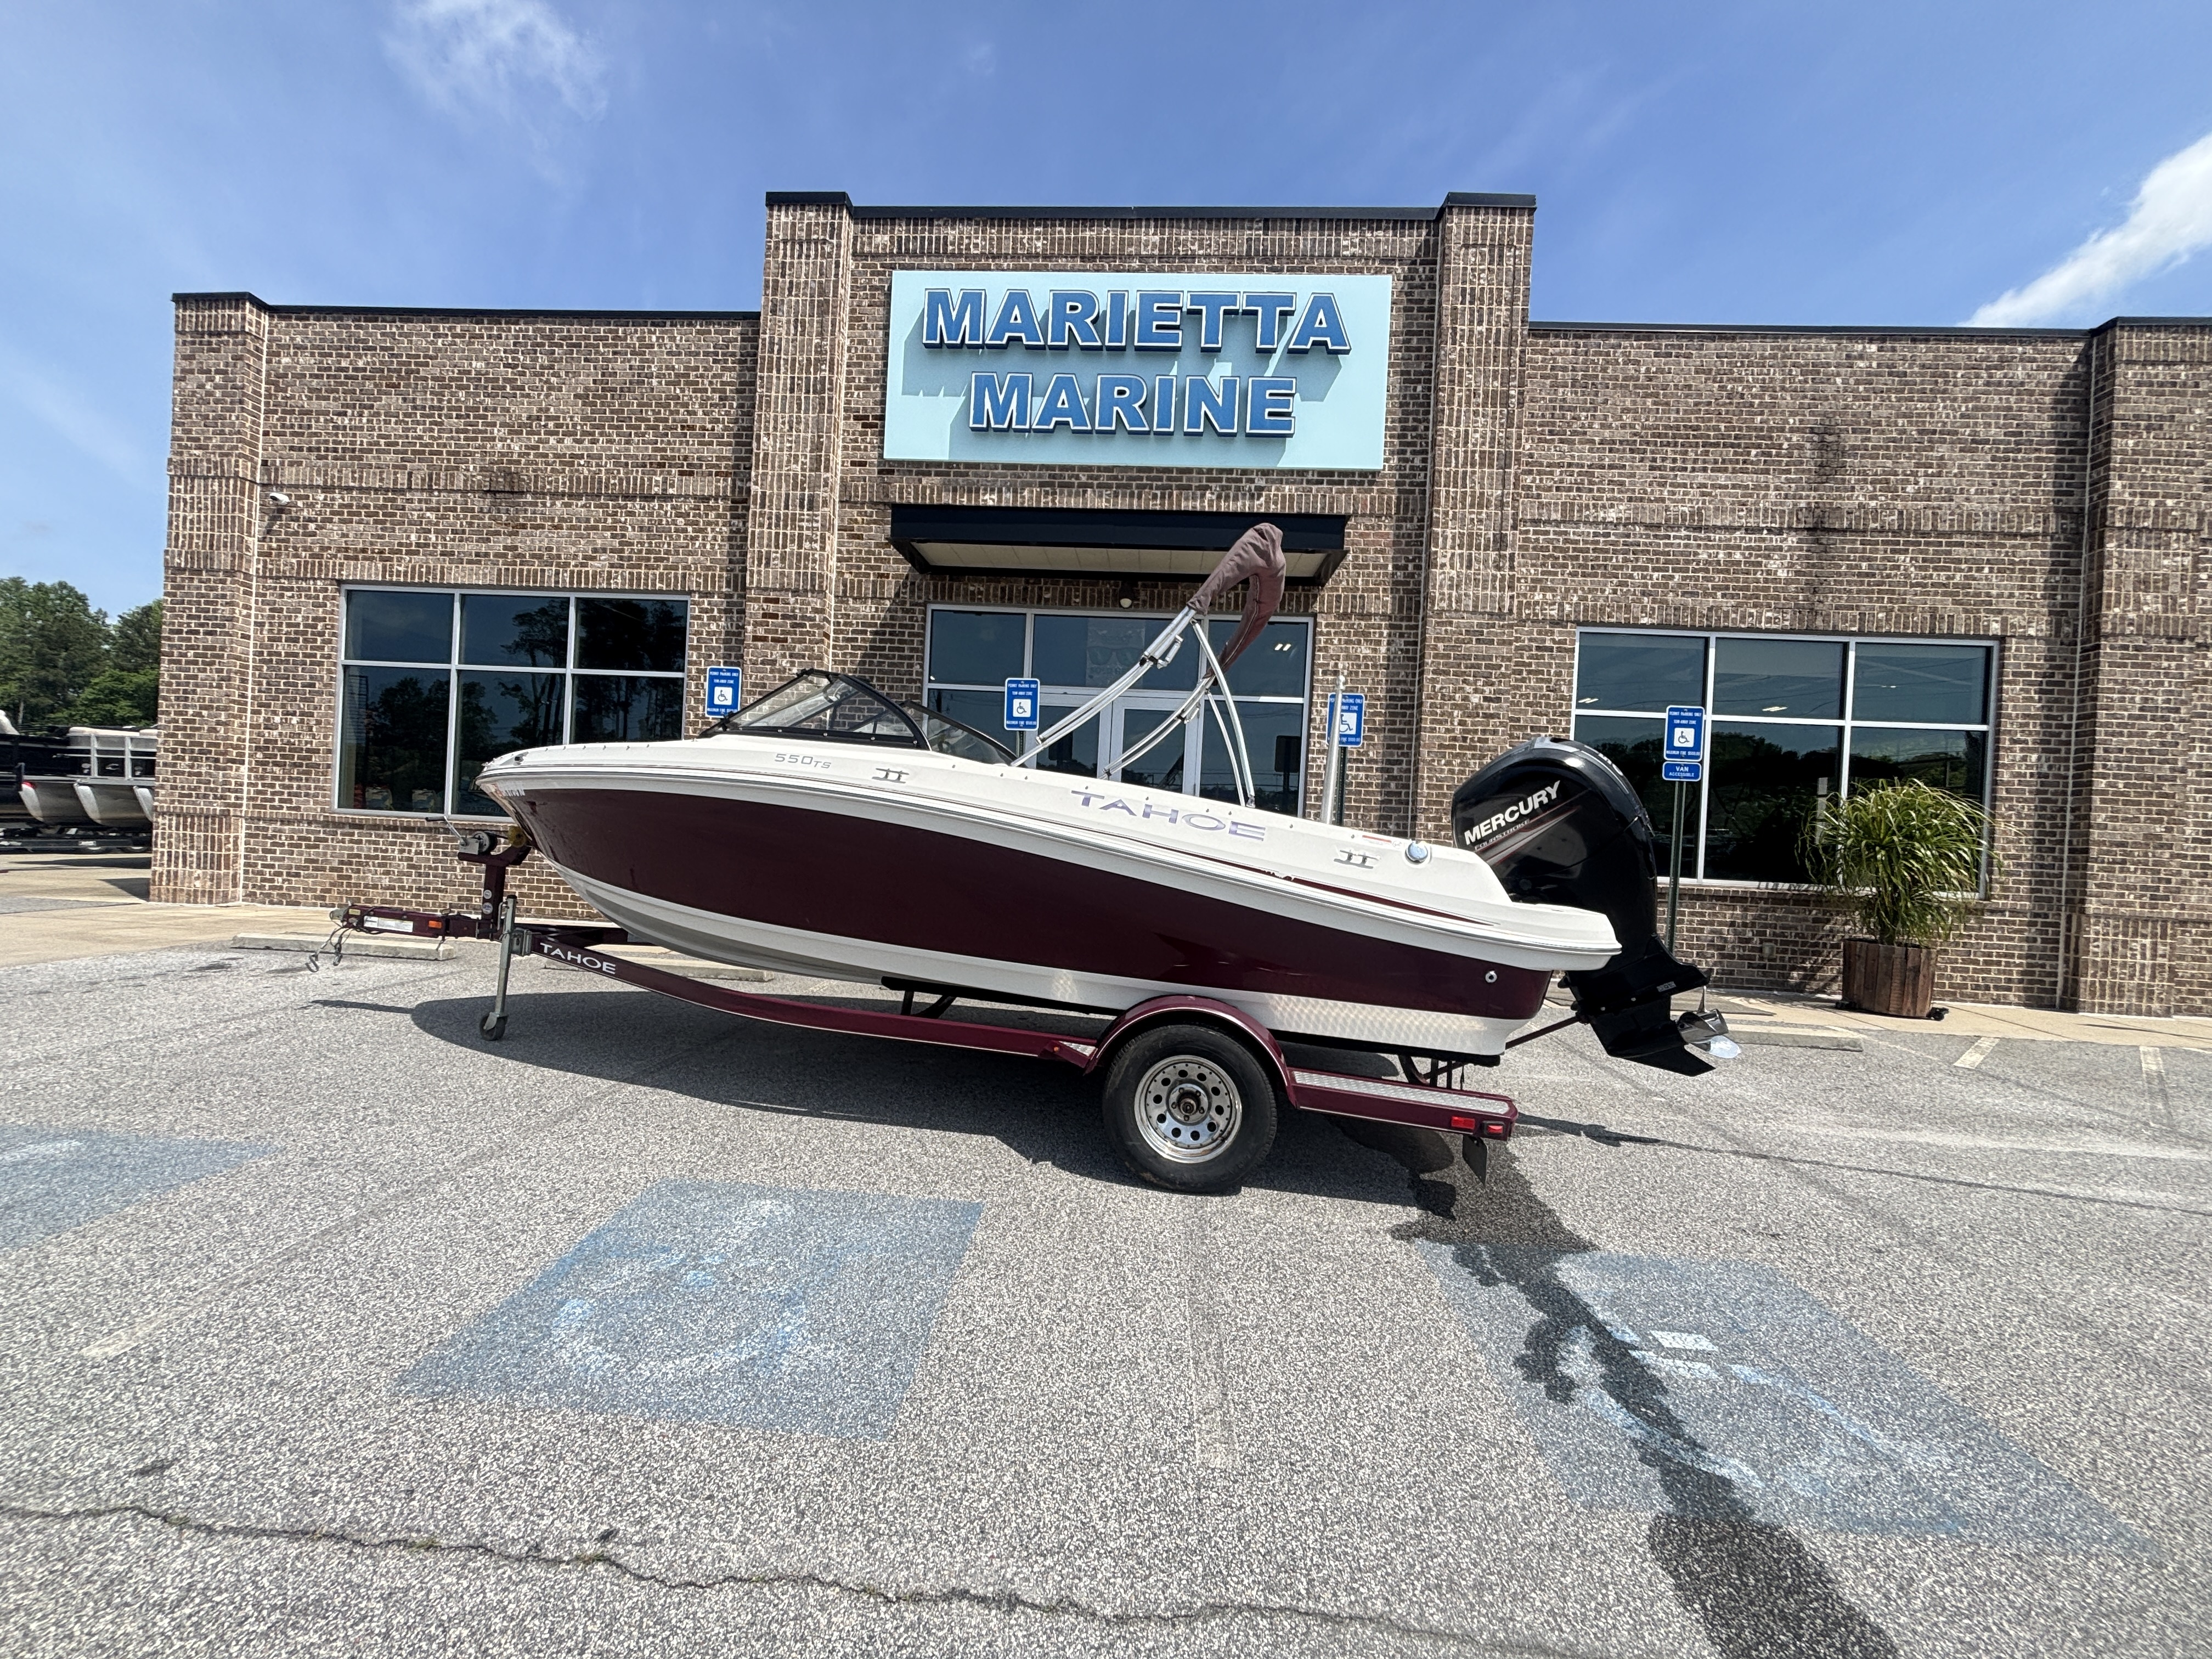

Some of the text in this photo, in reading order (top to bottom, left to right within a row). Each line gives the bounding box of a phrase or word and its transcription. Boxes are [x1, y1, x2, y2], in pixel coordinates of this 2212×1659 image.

[922, 289, 1351, 354] MARIETTA
[969, 371, 1296, 438] MARINE
[774, 753, 832, 769] 550TS
[1071, 790, 1266, 842] TAHOE
[1464, 780, 1560, 845] MERCURY
[1475, 819, 1530, 851] FOURSTROKE
[540, 942, 616, 974] TAHOE
